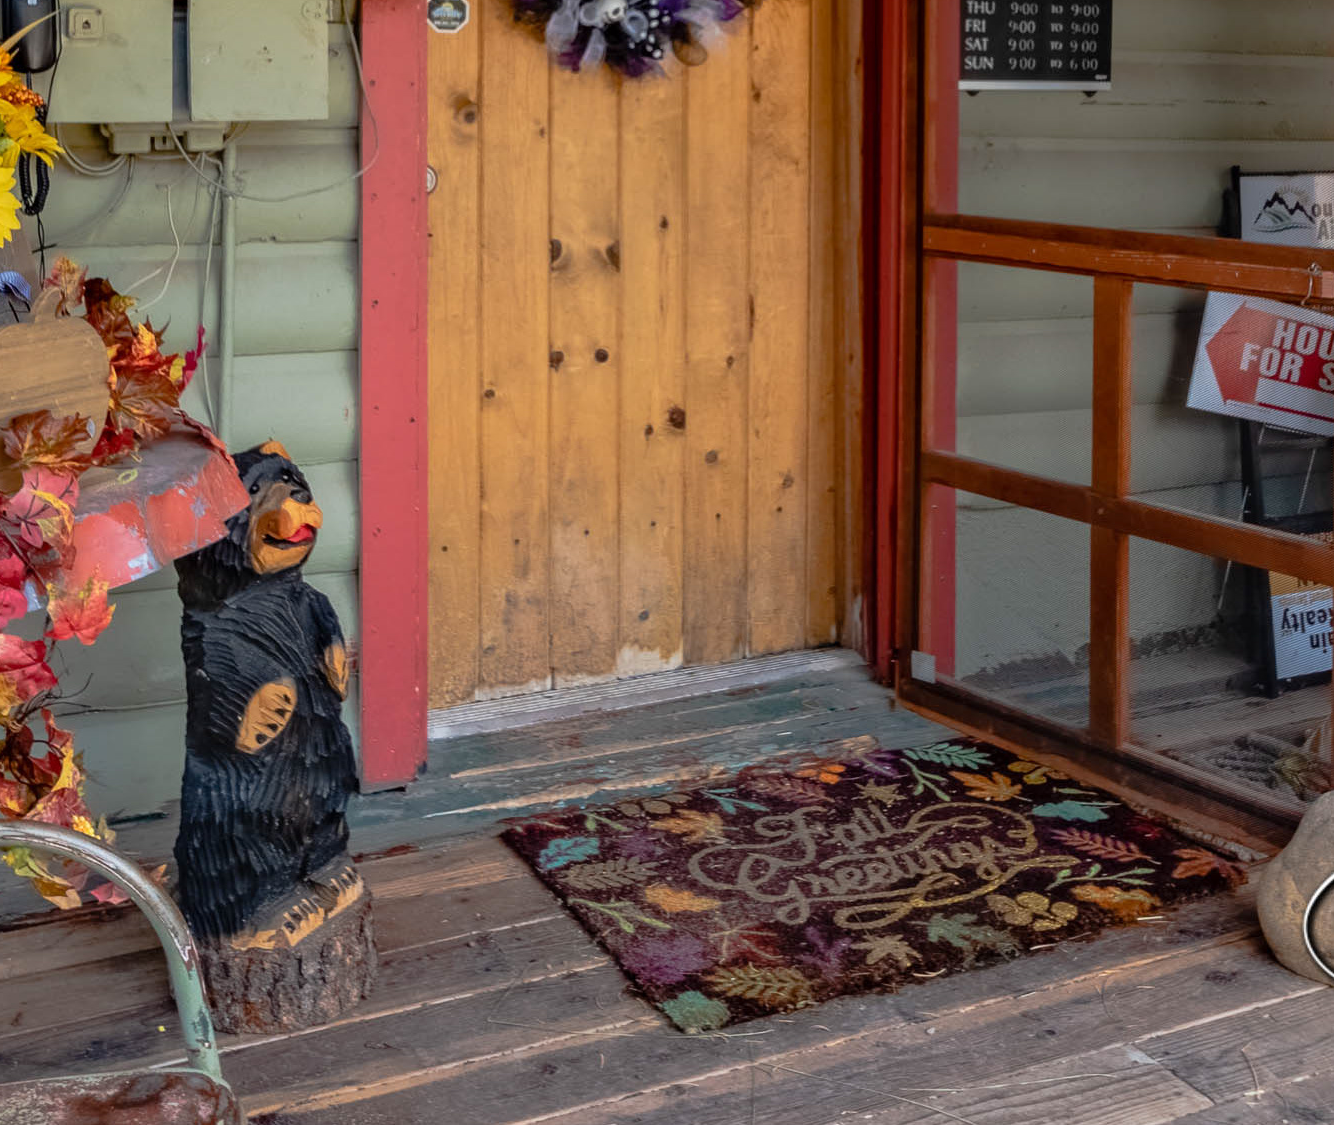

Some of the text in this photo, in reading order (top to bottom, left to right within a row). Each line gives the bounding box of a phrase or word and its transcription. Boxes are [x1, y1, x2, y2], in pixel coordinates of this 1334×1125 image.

[967, 1, 995, 15] THU
[1010, 2, 1038, 15] 9:00
[1070, 4, 1099, 17] 9:00
[965, 19, 986, 33] FRI
[1008, 20, 1036, 34] 9:00
[1070, 22, 1099, 35] 9:00
[965, 37, 989, 51] SAT
[965, 56, 994, 70] SUN
[1240, 342, 1304, 383] FOR
[754, 804, 903, 866] Fall
[732, 832, 1039, 927] Greetings
